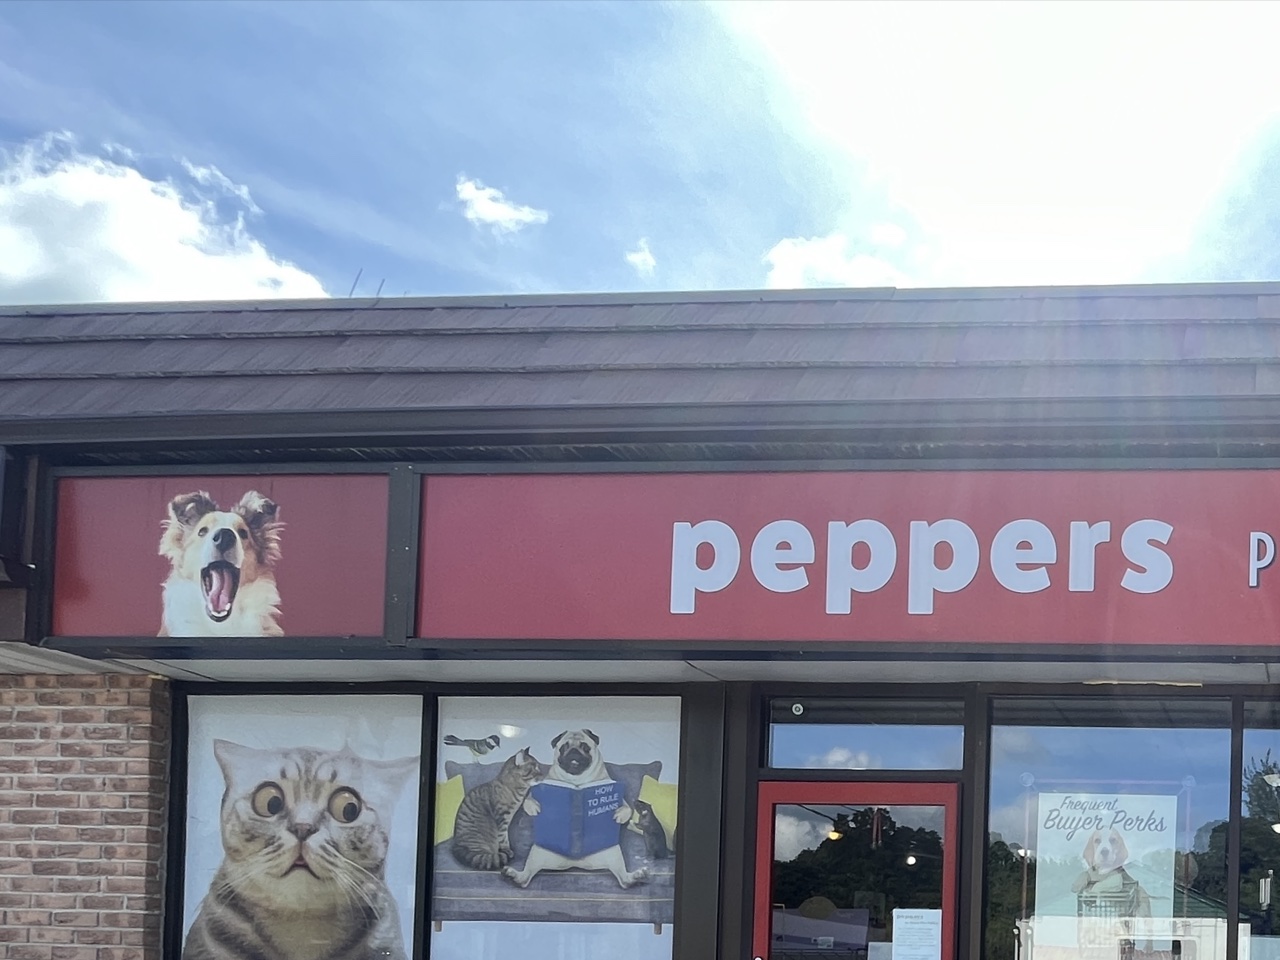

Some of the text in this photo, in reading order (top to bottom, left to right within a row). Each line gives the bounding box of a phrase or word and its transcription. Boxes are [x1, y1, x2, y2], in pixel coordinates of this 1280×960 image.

[670, 519, 1175, 614] peppers
[595, 785, 614, 795] HOW
[588, 793, 619, 807] TO RULE
[1060, 796, 1118, 814] Frequent
[588, 802, 619, 817] HUMANS
[1044, 808, 1167, 841] Buyer Perks
